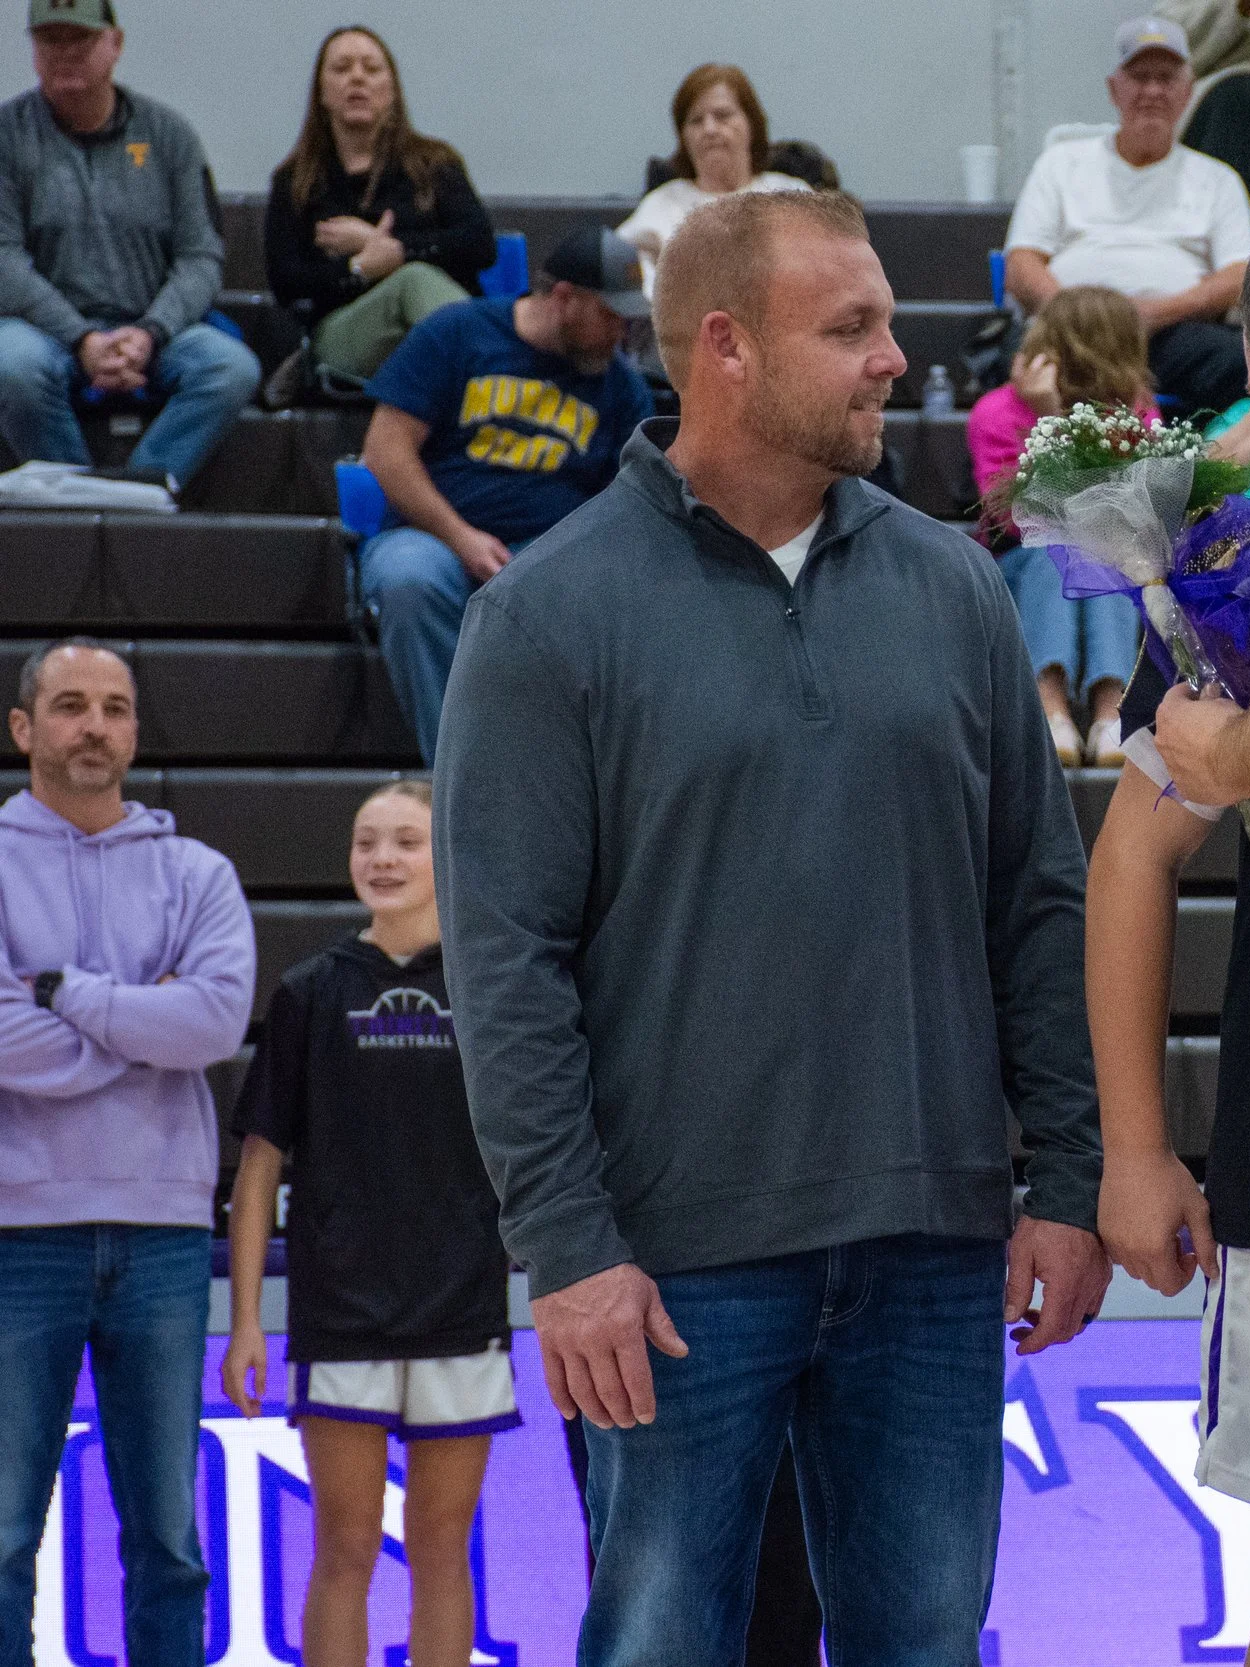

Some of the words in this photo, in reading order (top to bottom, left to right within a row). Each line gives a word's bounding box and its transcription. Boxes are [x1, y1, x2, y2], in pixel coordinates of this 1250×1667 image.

[459, 374, 599, 456] MURRAY
[466, 423, 569, 472] STATE
[357, 1034, 454, 1050] BASKETBALL
